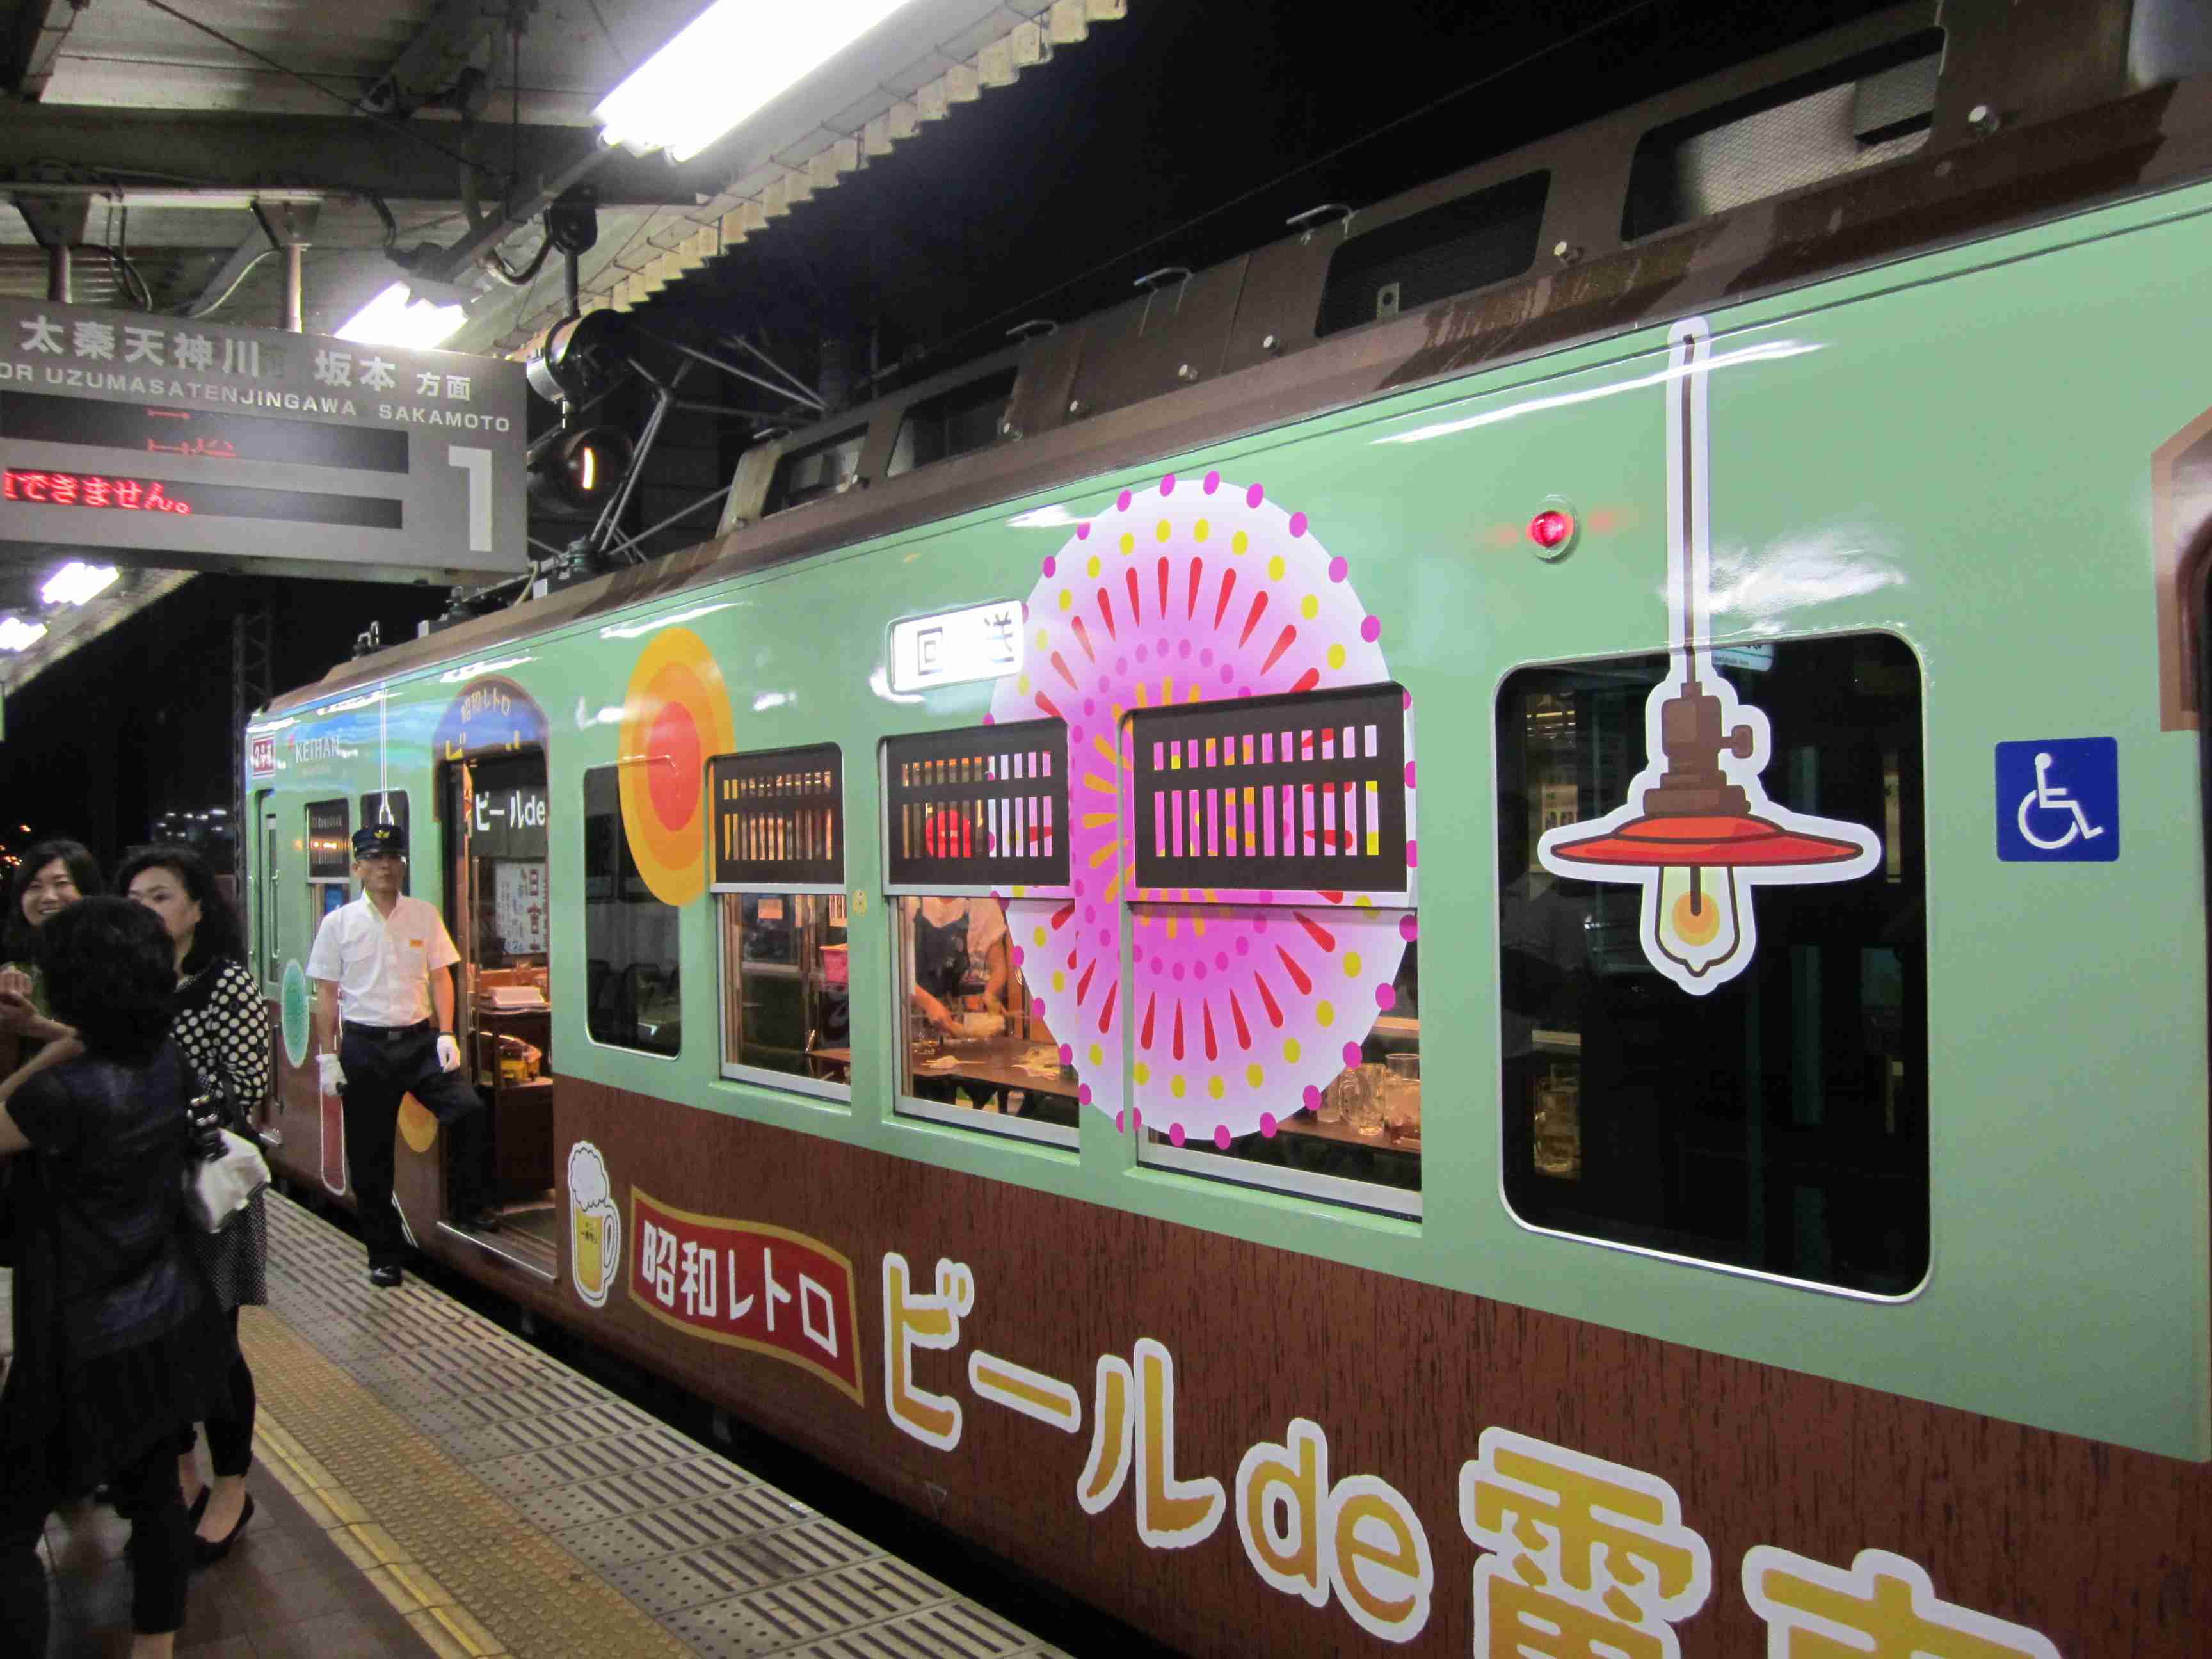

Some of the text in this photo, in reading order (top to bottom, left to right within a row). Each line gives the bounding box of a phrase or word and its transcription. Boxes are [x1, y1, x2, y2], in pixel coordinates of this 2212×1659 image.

[20, 315, 471, 401] 太秦天神川 坂本 方面
[45, 367, 357, 415] UZUMASATENJINGAWA
[378, 404, 510, 433] SAKAMOTO
[449, 445, 492, 552] 1
[641, 1220, 838, 1358] 昭和レトロ
